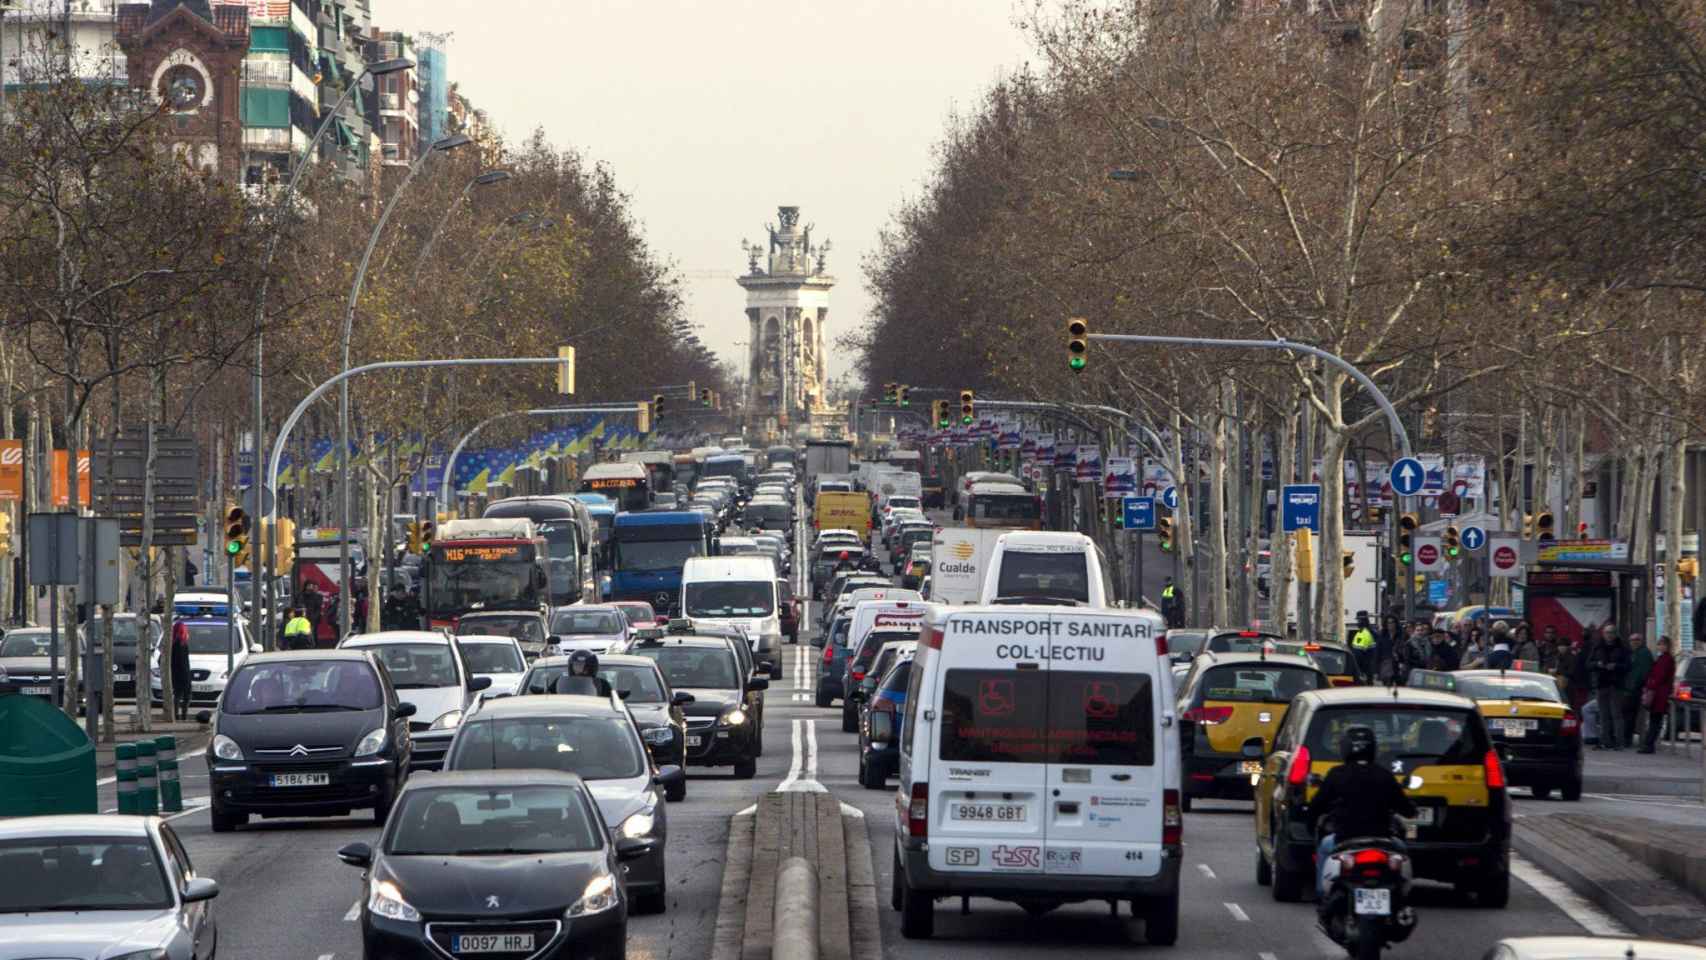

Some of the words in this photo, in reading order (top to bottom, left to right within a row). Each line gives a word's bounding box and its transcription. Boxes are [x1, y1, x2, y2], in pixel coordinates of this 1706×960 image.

[1296, 514, 1312, 525] taxi
[939, 562, 976, 574] Cualde
[951, 619, 1062, 635] TRANSPORT
[1068, 622, 1151, 638] SANITARI
[996, 644, 1104, 661] COL·LECTIU
[949, 768, 992, 776] TRANSIT
[276, 775, 303, 785] 5184
[960, 806, 993, 818] 9948
[998, 807, 1023, 819] GBT
[951, 850, 975, 863] SP
[1125, 851, 1143, 861] 414
[462, 936, 498, 950] 0097
[504, 936, 532, 949] HRJ
